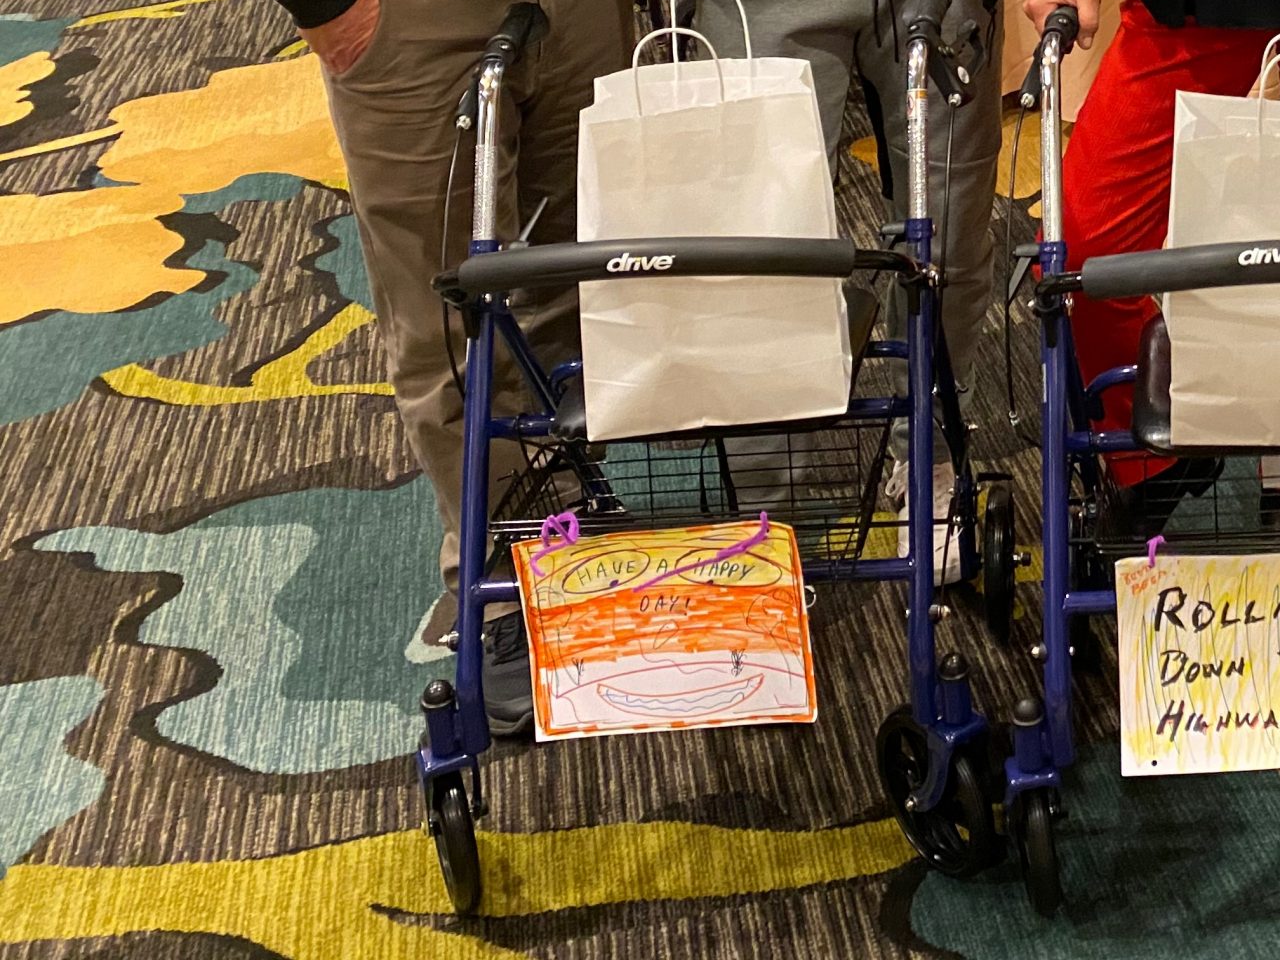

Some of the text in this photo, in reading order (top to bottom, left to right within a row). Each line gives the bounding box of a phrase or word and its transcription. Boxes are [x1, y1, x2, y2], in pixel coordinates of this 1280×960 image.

[606, 252, 674, 273] drive
[576, 558, 638, 587] HAVE
[656, 558, 669, 574] A
[1160, 649, 1245, 687] DOWN
